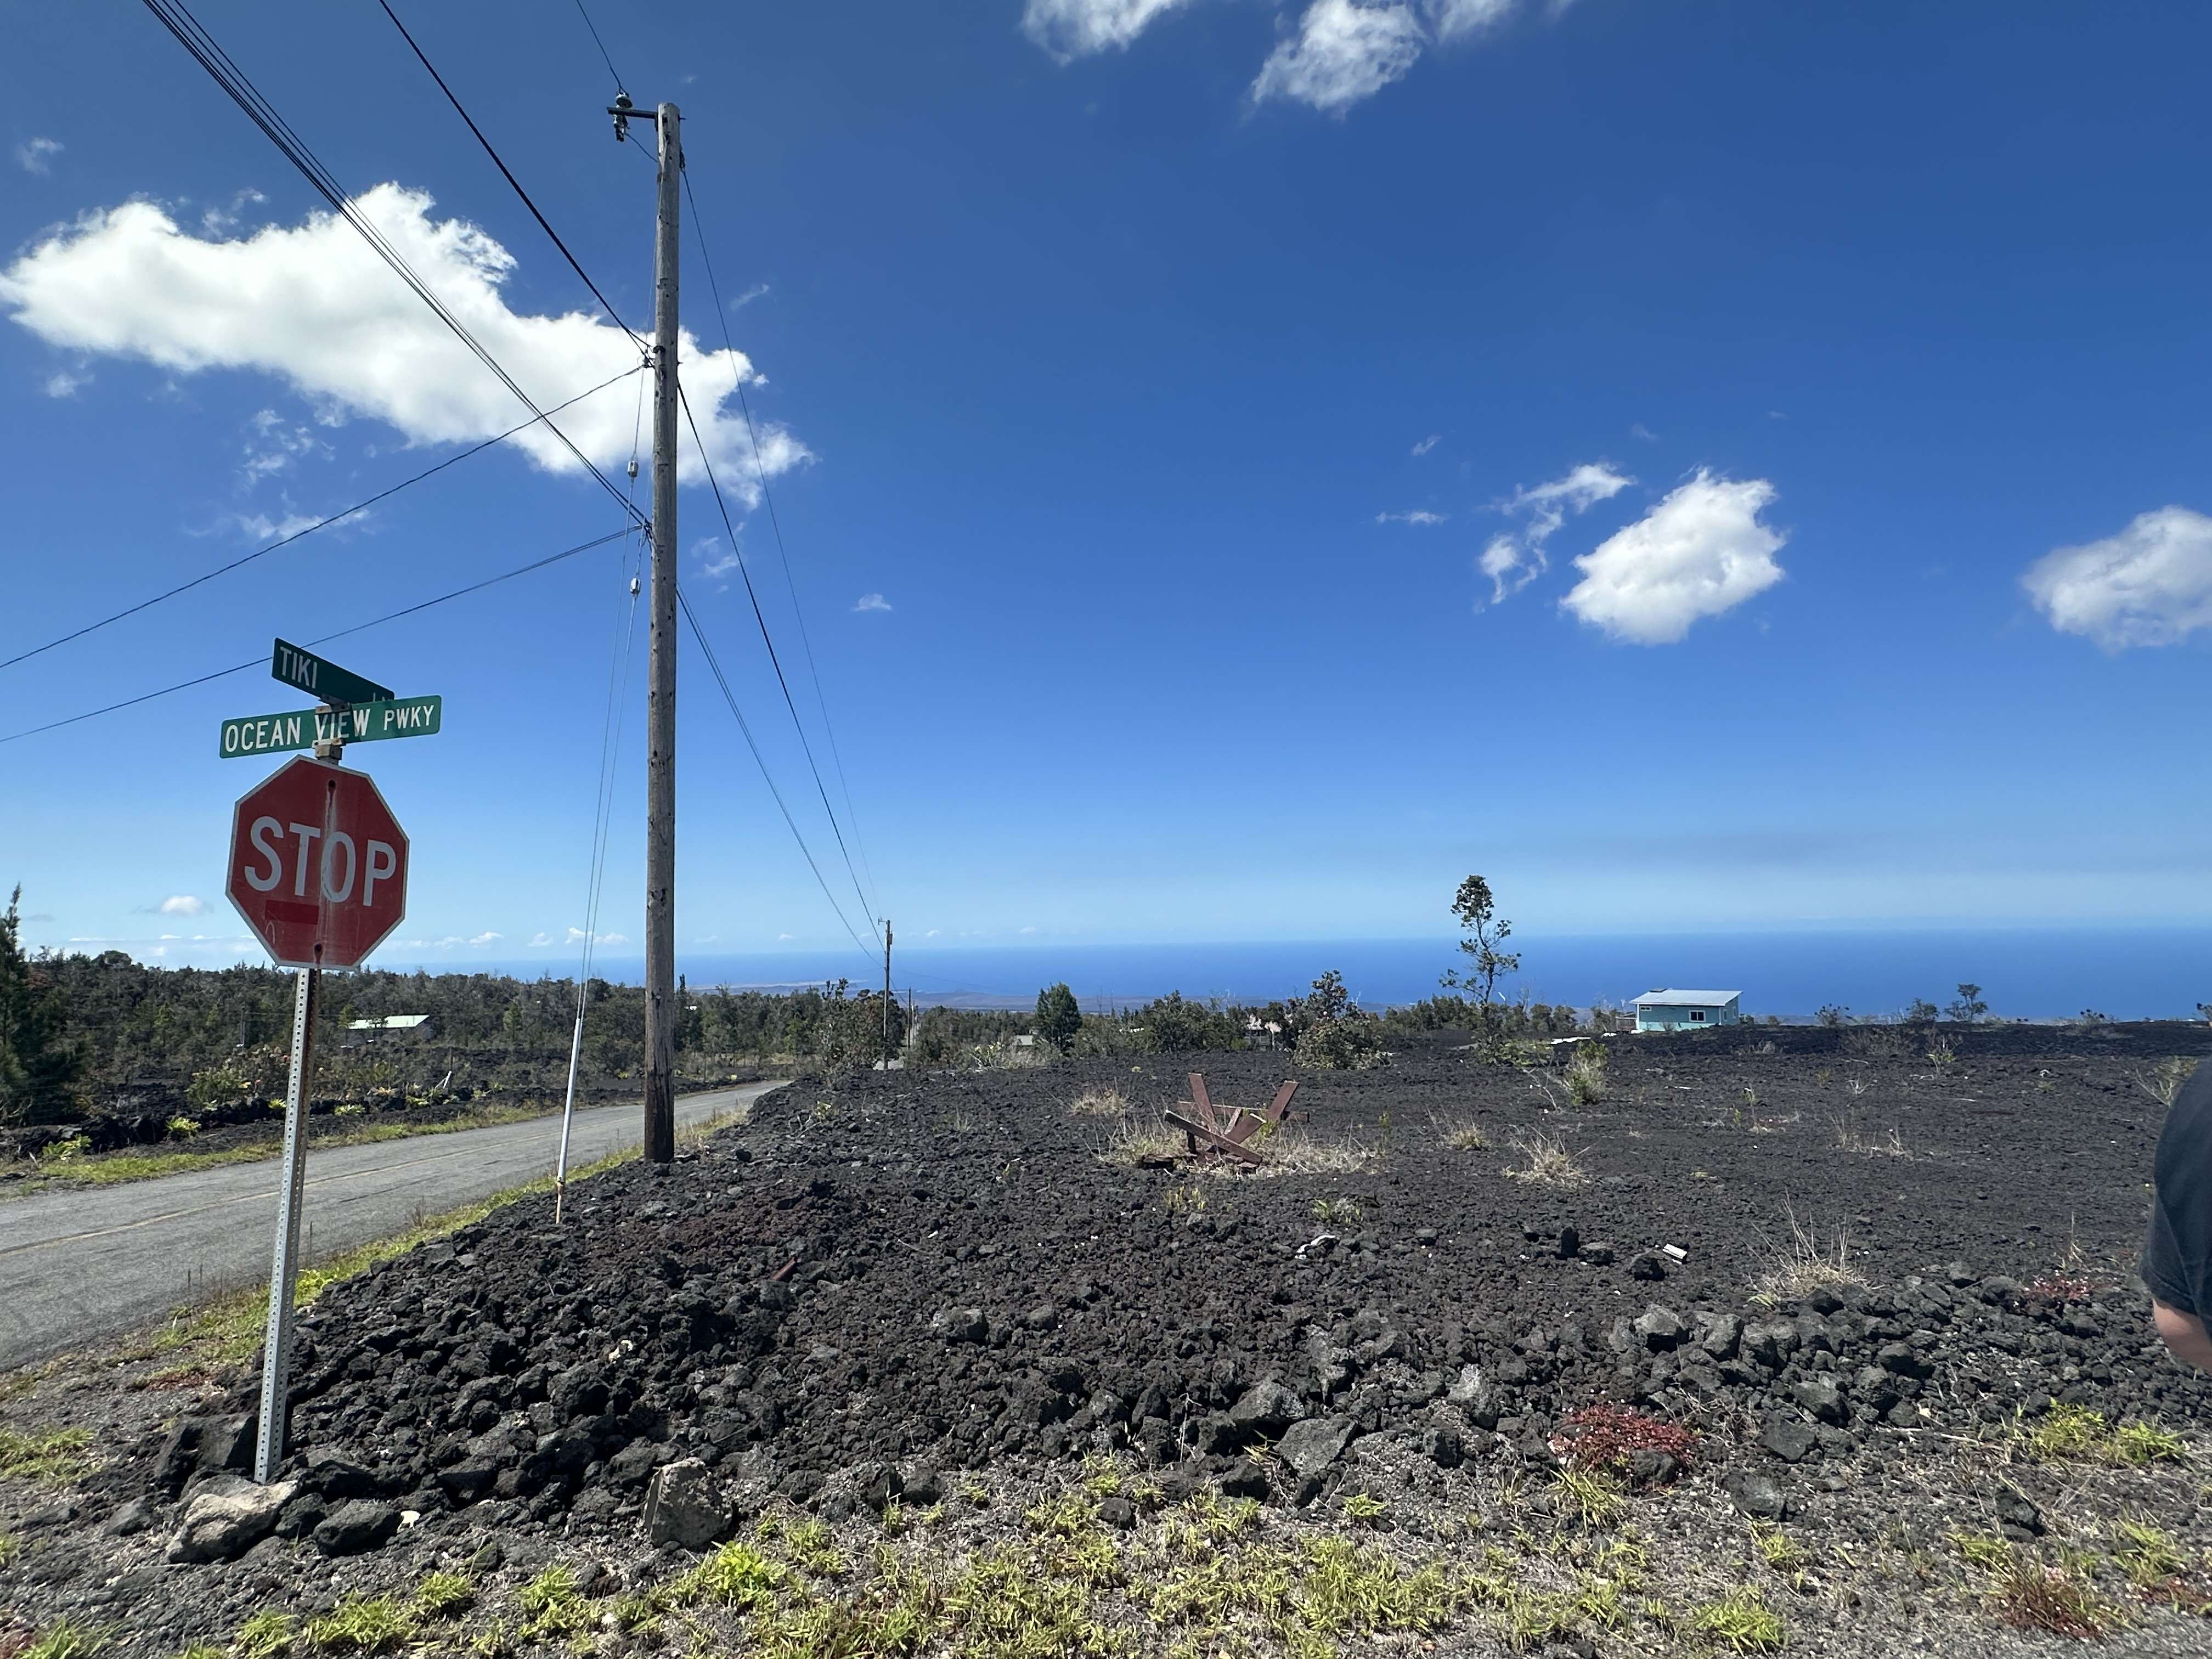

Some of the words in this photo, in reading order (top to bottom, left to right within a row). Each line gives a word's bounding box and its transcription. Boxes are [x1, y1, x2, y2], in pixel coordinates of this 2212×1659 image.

[280, 646, 317, 689] TIKI
[225, 716, 301, 752] OCEAN
[314, 709, 370, 741] VIEW
[383, 704, 435, 730] PWKY
[244, 815, 396, 906] STOP
